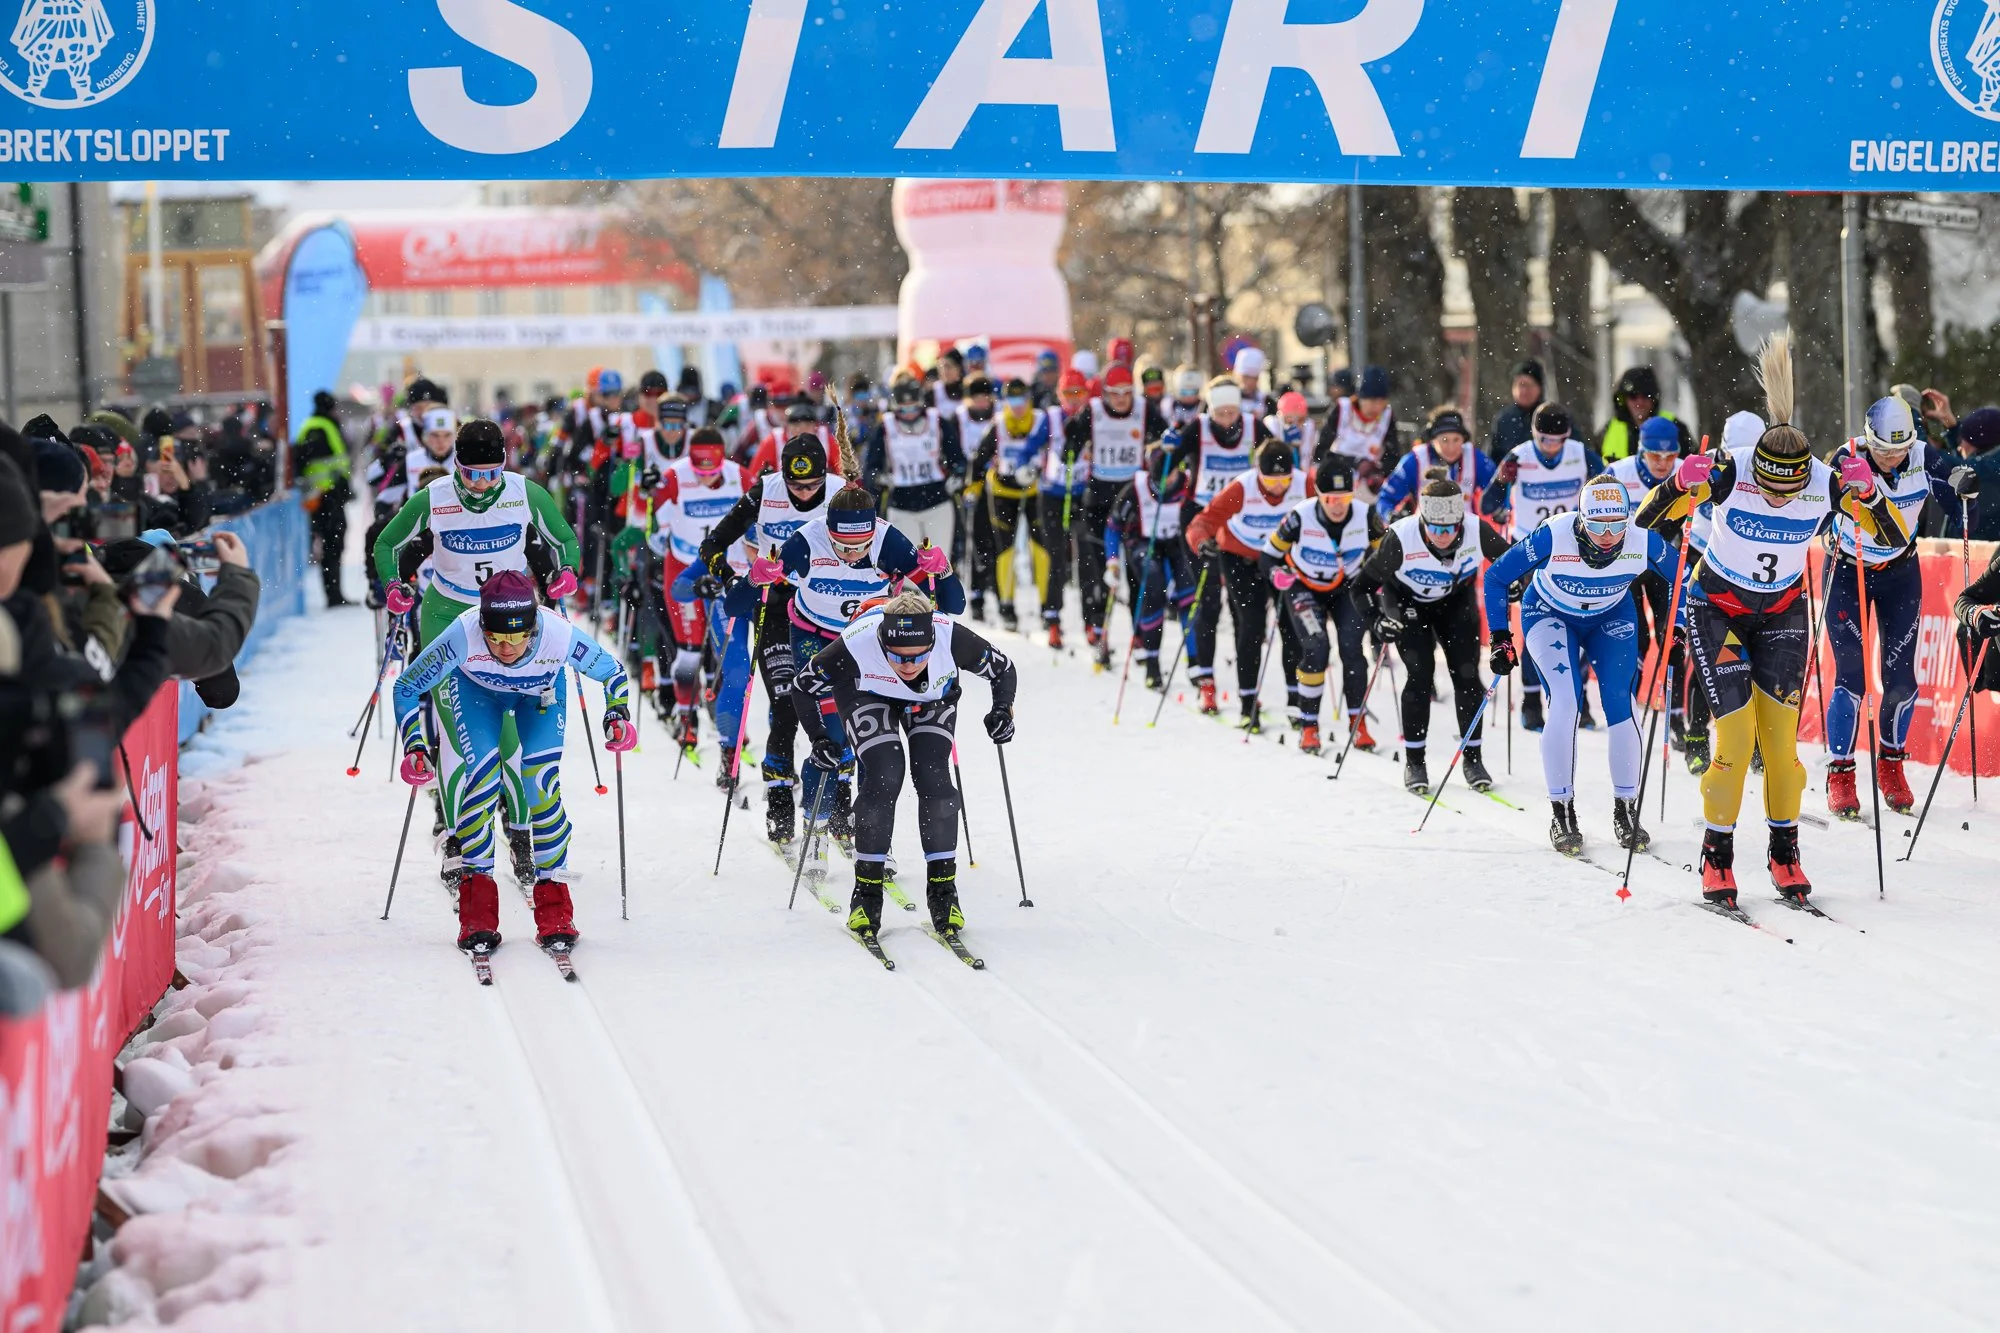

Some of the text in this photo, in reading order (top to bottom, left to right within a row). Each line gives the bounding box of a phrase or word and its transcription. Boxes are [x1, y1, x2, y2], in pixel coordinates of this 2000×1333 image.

[1939, 20, 1963, 86] ENGELBREKTS
[96, 52, 135, 90] NORBERG
[1850, 140, 2000, 172] ENGELBRE
[497, 500, 524, 509] LACTIGO
[1595, 494, 1623, 504] skog
[1740, 526, 1812, 541] AB KARL HEDIN
[452, 535, 518, 551] AB KARL HEDIN
[474, 561, 493, 586] 5
[1752, 553, 1778, 583] 3
[1563, 583, 1576, 593] AB
[1577, 587, 1601, 595] KARL
[841, 600, 861, 617] 6
[423, 651, 437, 668] SKI
[1688, 607, 1720, 705] SWEDEMOUNT
[457, 722, 476, 765] FUND
[857, 876, 882, 884] FISCHER
